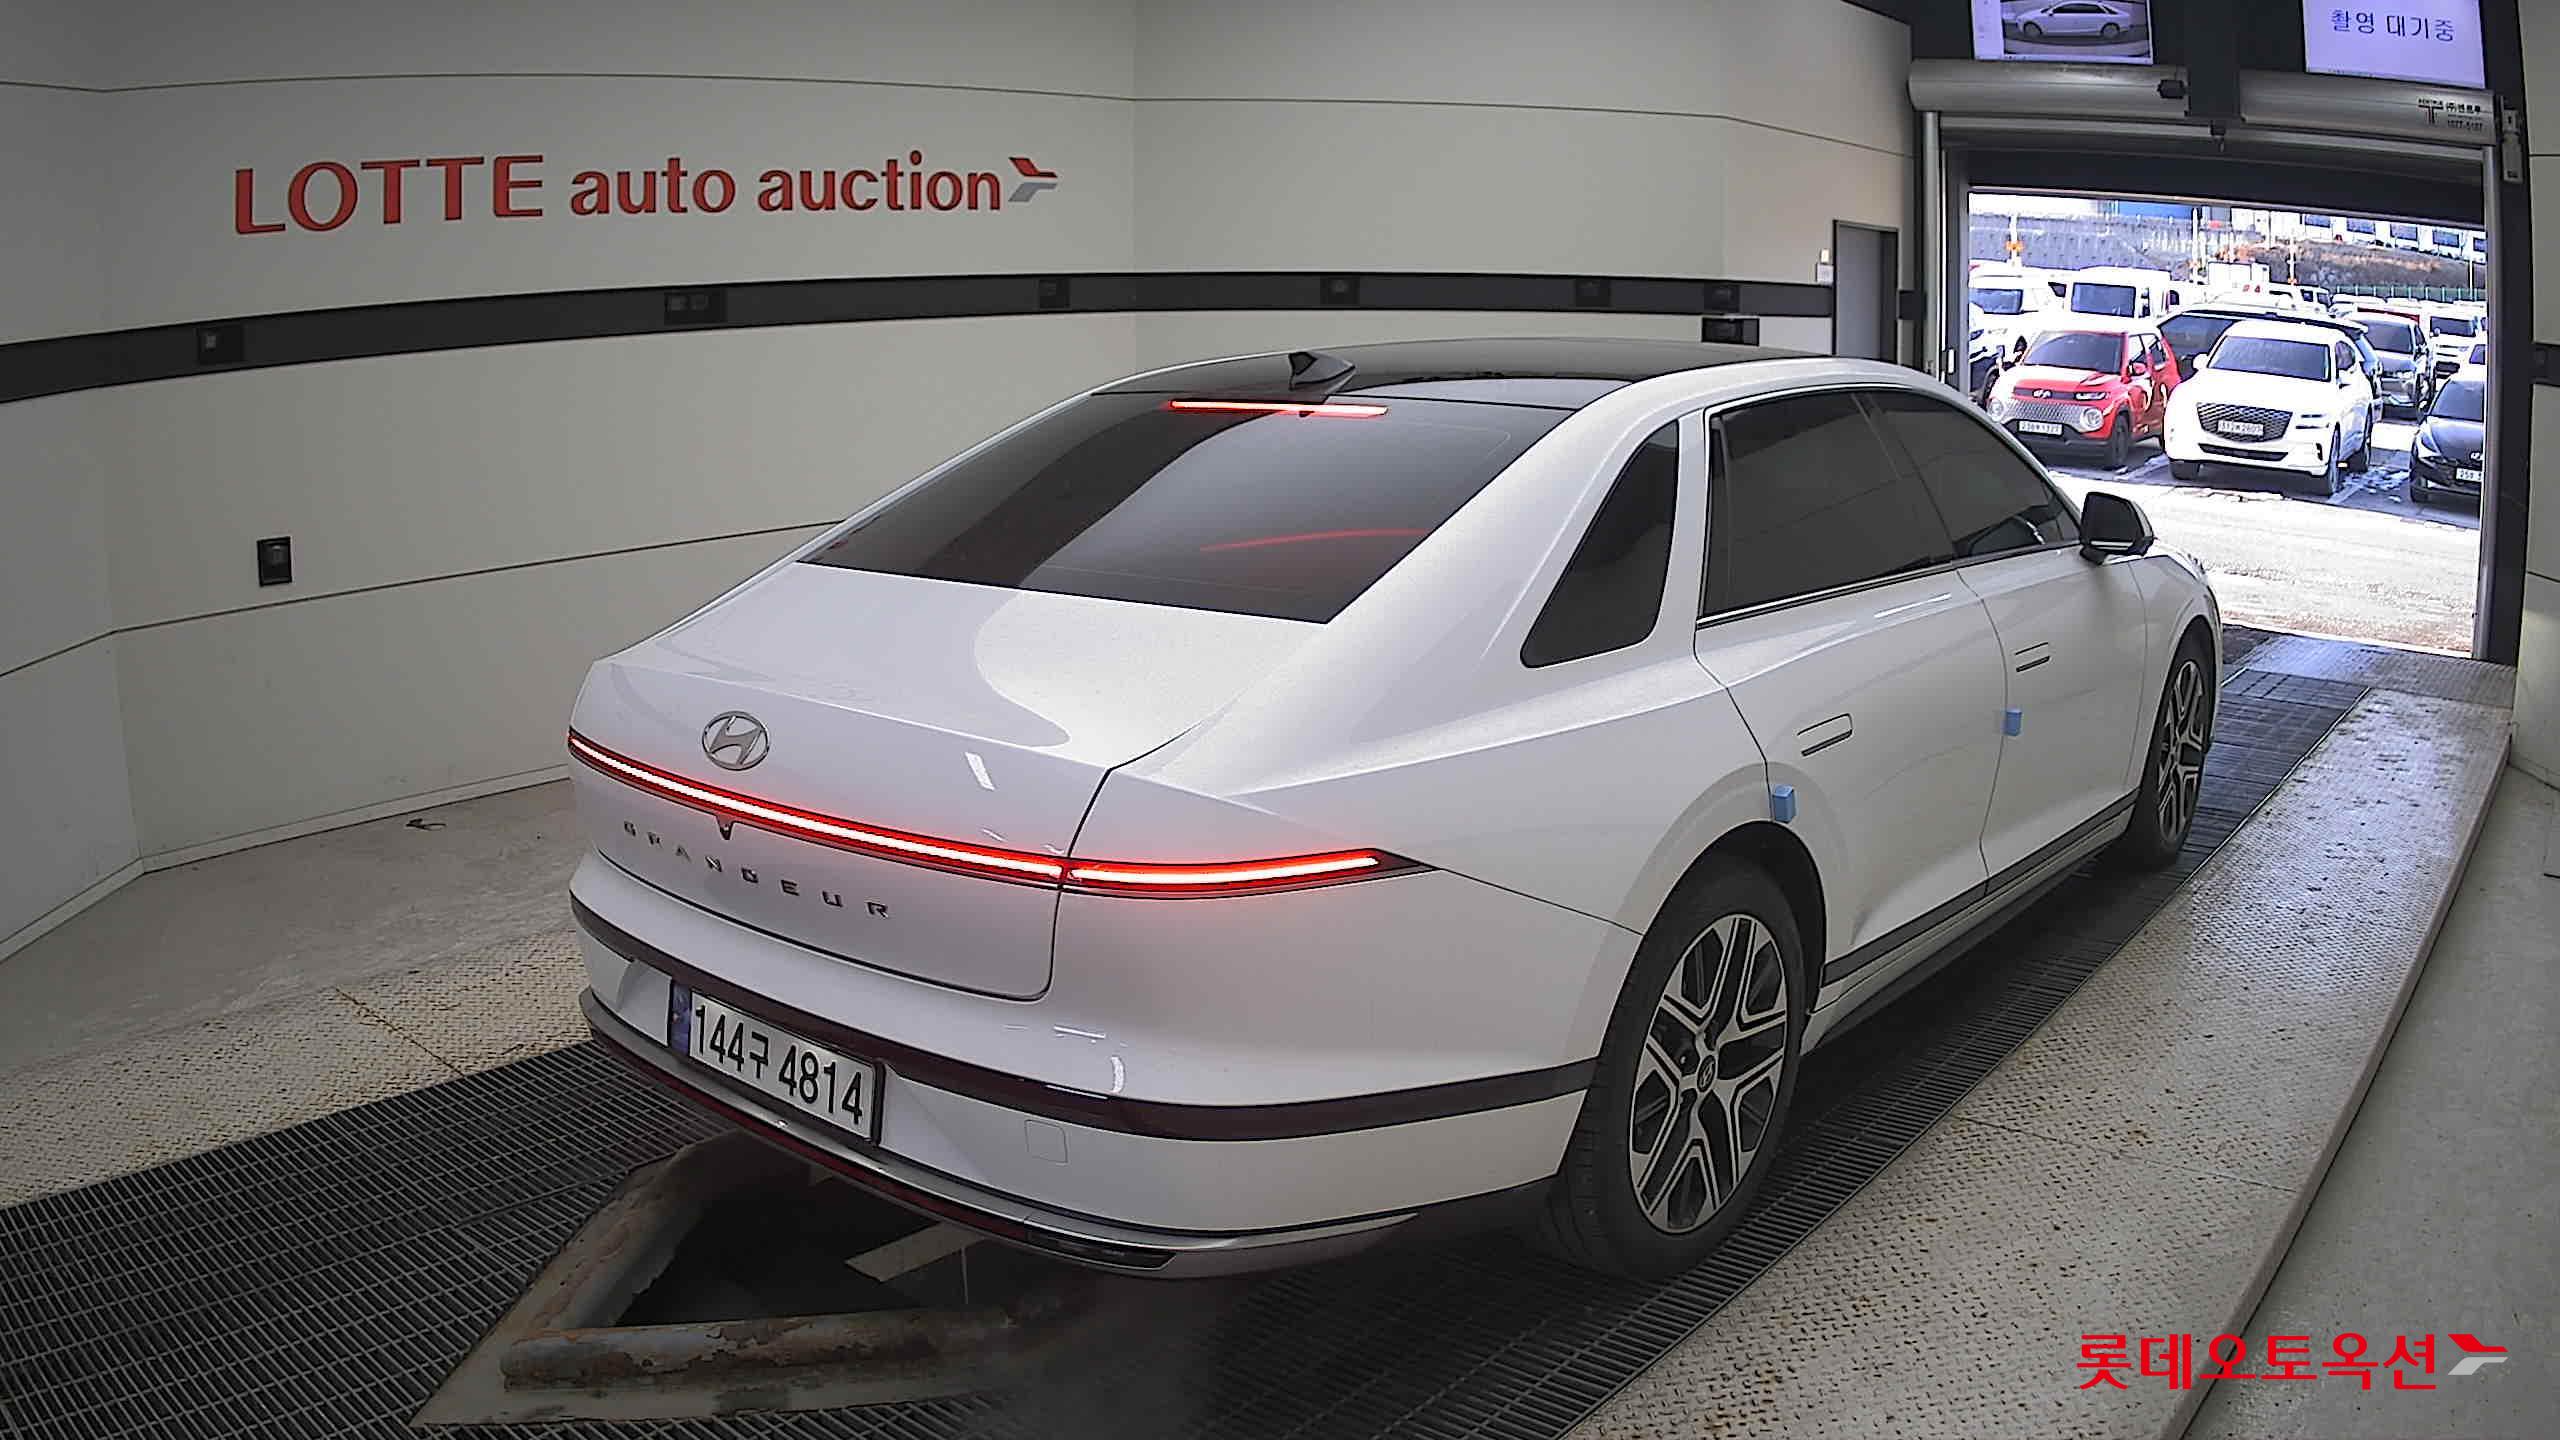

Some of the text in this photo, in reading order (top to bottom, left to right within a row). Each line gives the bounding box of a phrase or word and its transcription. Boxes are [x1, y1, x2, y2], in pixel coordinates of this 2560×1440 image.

[2330, 9, 2455, 42] 촬영 대기중
[235, 151, 1002, 235] LOTTE auto auction
[623, 820, 891, 920] GRANDEUR
[694, 1003, 864, 1126] 144구 4814
